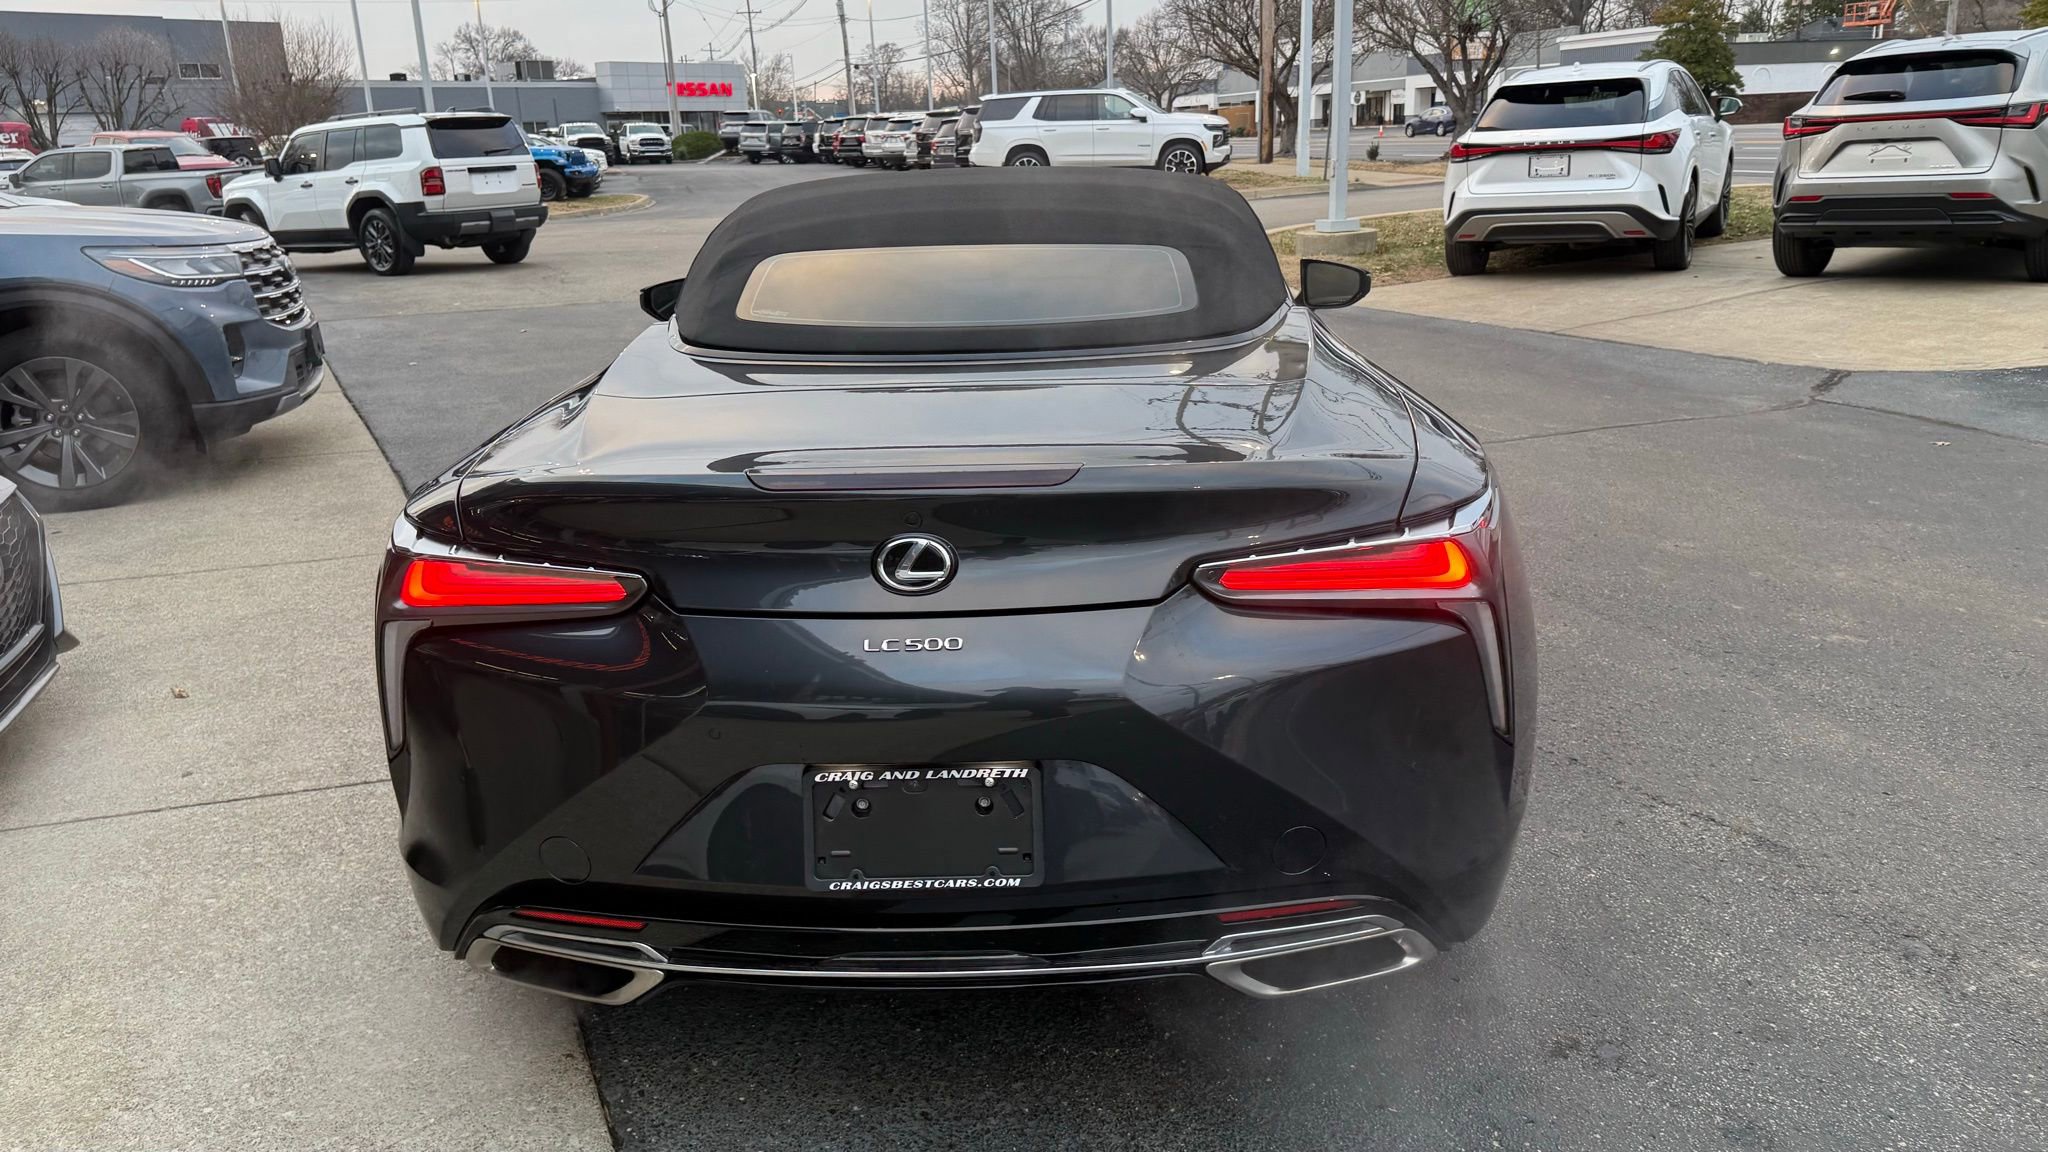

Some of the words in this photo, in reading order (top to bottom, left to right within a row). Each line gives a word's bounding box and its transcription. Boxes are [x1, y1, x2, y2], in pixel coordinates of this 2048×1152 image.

[863, 639, 900, 652] LC
[904, 637, 963, 652] 500
[814, 770, 875, 783] CRAIG
[878, 770, 920, 780] AND
[925, 768, 1029, 779] LANDRETH
[829, 878, 1021, 891] CRAIGSBESTCARS.COM
